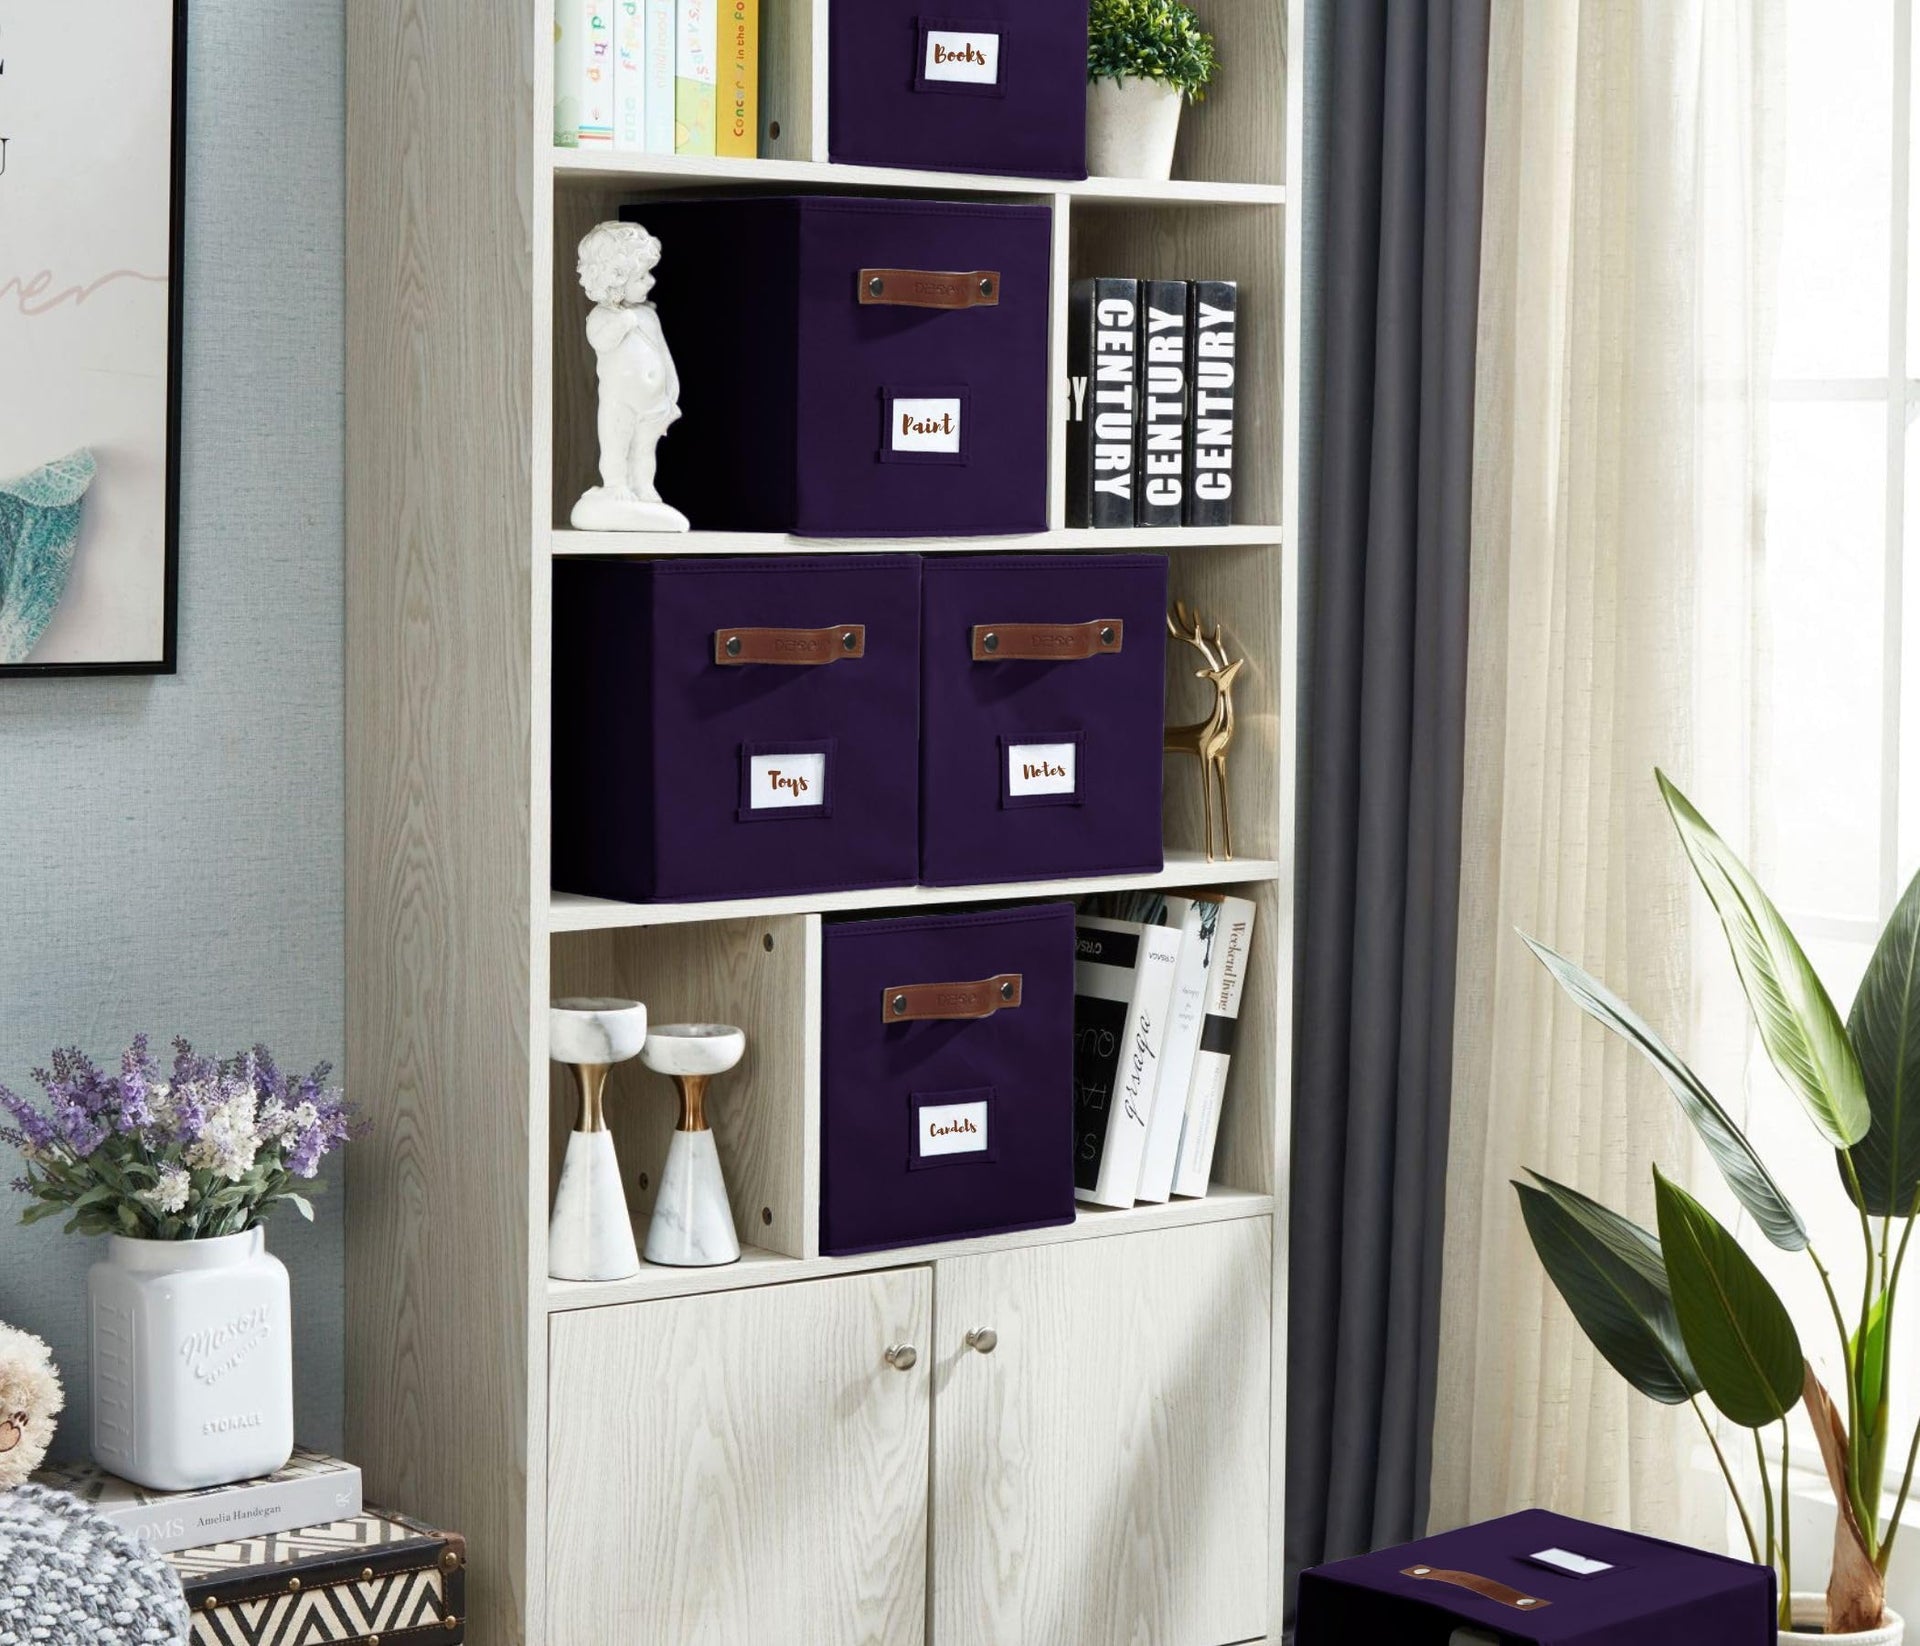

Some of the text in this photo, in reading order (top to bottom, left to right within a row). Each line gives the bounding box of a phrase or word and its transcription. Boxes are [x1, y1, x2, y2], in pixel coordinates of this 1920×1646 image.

[934, 42, 987, 65] Books
[1094, 298, 1135, 500] CENTURY
[1146, 306, 1184, 506] CENTURY
[1195, 302, 1235, 500] CENTURY
[902, 412, 955, 436] Paint
[767, 770, 810, 797] Toys
[1023, 761, 1067, 780] Notes
[1218, 922, 1246, 1011] Weekend living
[201, 1411, 265, 1436] STORAGE
[196, 1512, 232, 1528] Amelia
[233, 1504, 282, 1521] Handegan
